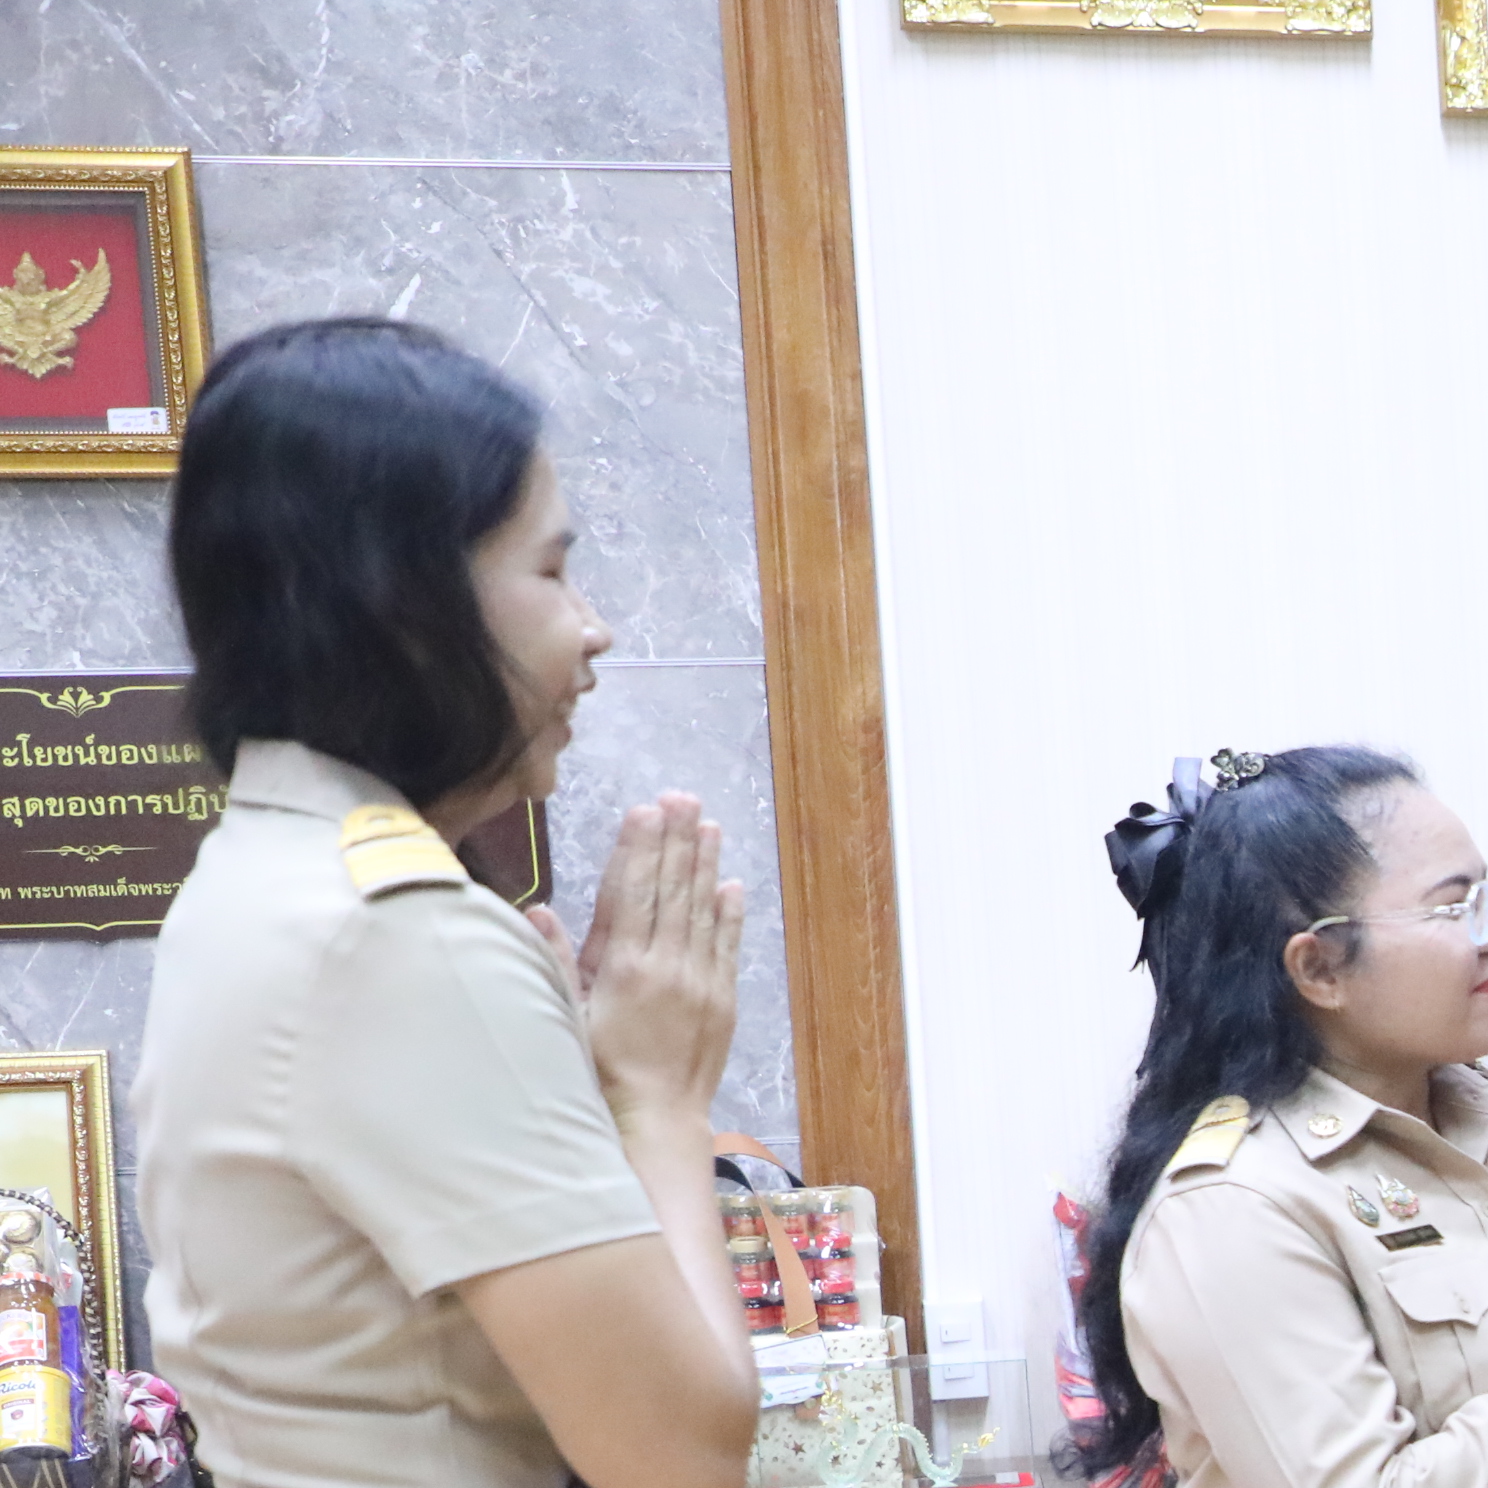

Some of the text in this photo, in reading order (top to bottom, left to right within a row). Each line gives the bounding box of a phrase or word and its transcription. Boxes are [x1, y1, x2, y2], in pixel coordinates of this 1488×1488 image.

[18, 876, 189, 899] พระบาทสมเด็จพระว
